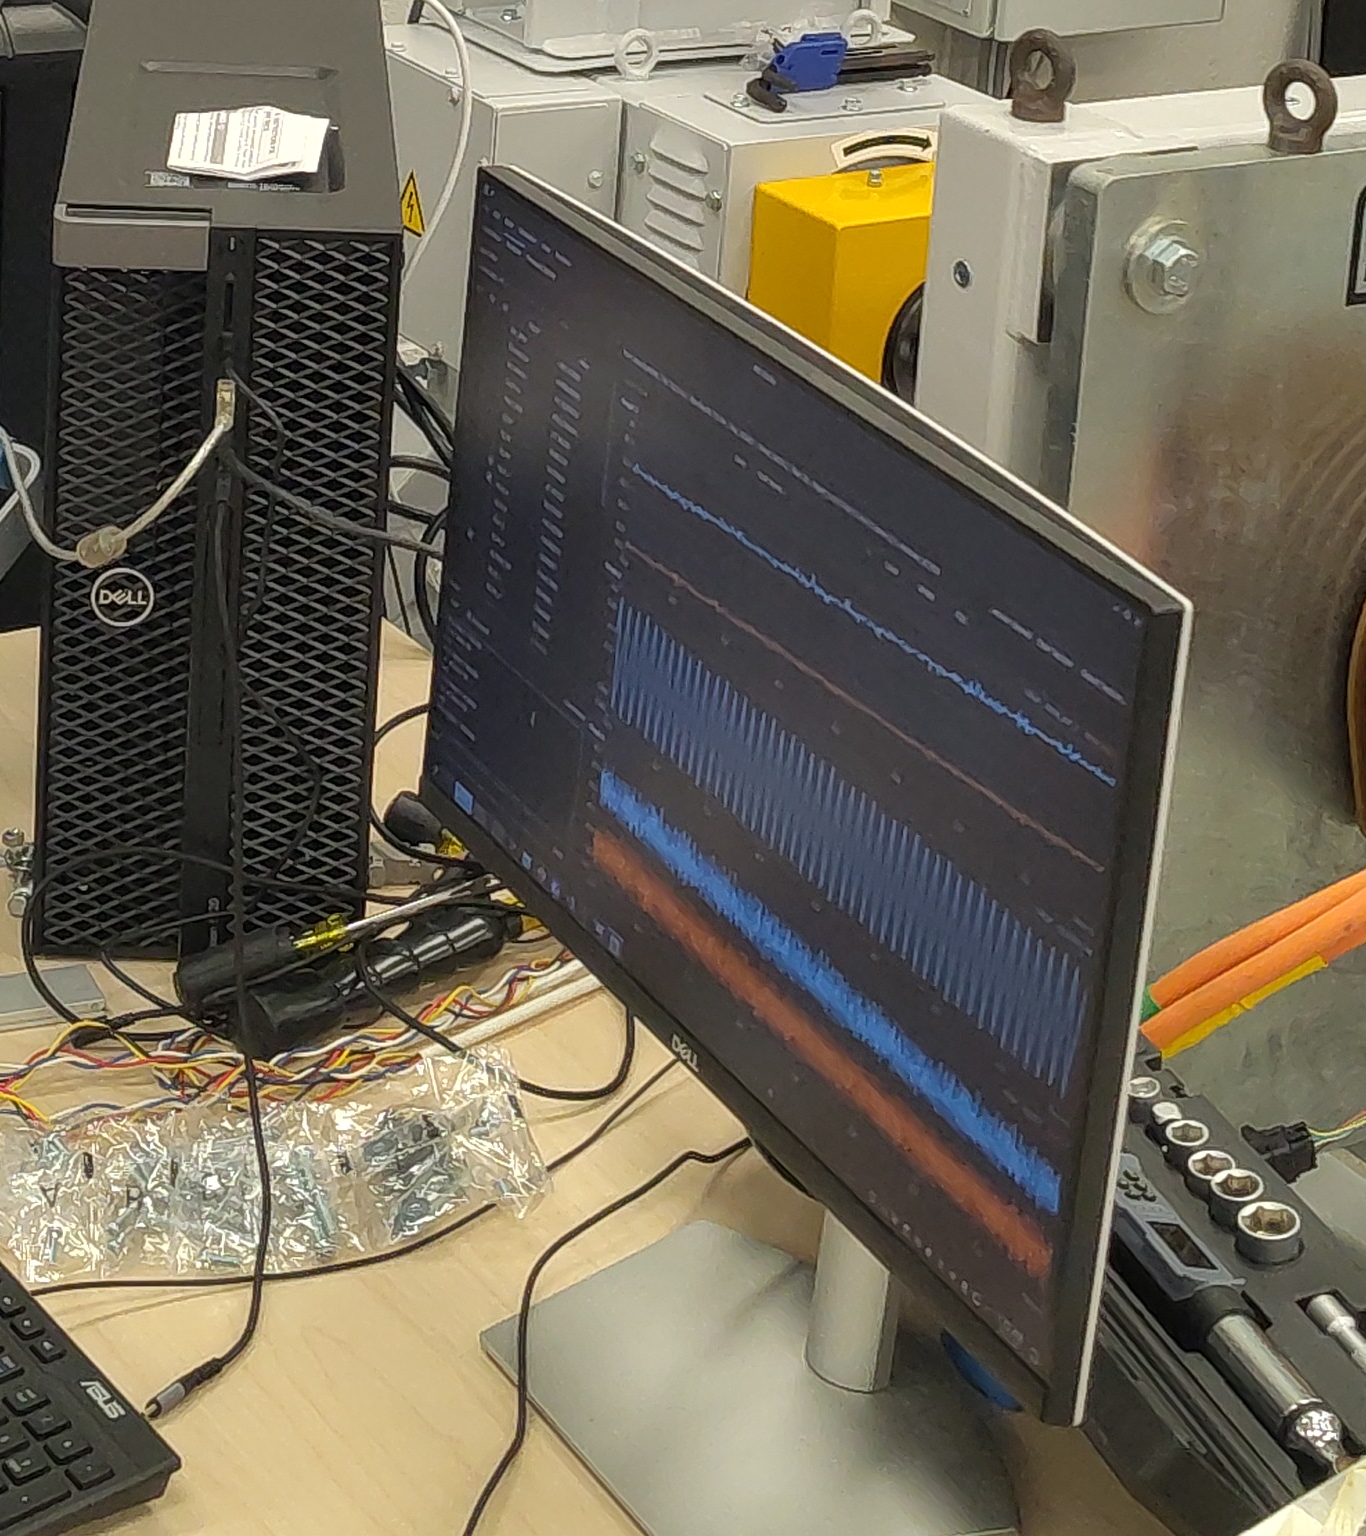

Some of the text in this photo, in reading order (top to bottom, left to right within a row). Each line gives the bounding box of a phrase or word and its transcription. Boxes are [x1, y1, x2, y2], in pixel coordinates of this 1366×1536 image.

[99, 589, 147, 605] DELL
[671, 1033, 700, 1073] DELL
[79, 1380, 126, 1419] ASUS
